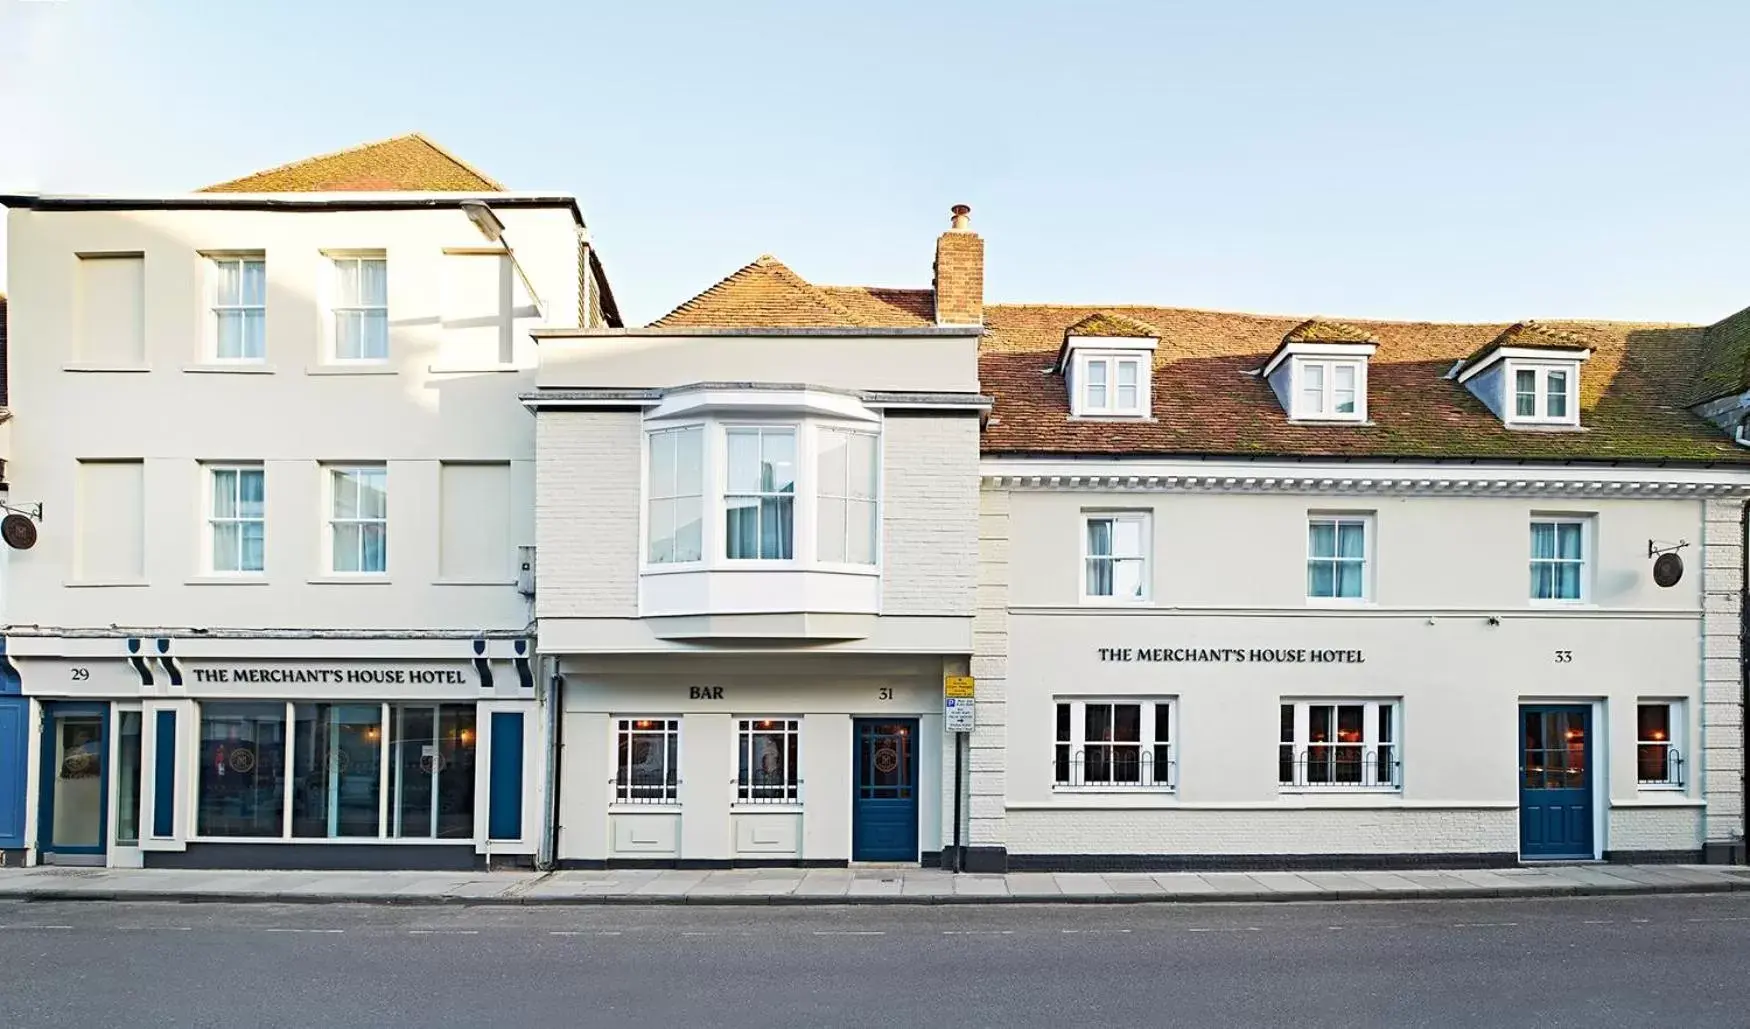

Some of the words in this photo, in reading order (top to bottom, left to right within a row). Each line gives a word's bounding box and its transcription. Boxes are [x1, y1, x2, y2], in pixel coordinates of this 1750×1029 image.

[1098, 648, 1132, 662] THE
[1137, 649, 1245, 662] MERCHANT'S
[1249, 649, 1306, 663] HOUSE
[1310, 650, 1365, 663] HOTEL
[1555, 651, 1572, 663] 33
[71, 667, 90, 681] 29
[193, 668, 229, 682] THE
[233, 669, 344, 683] MERCHANT'S
[347, 670, 405, 684] HOUSE
[409, 670, 466, 684] HOTEL
[689, 686, 724, 700] BAR
[879, 687, 893, 700] 31
